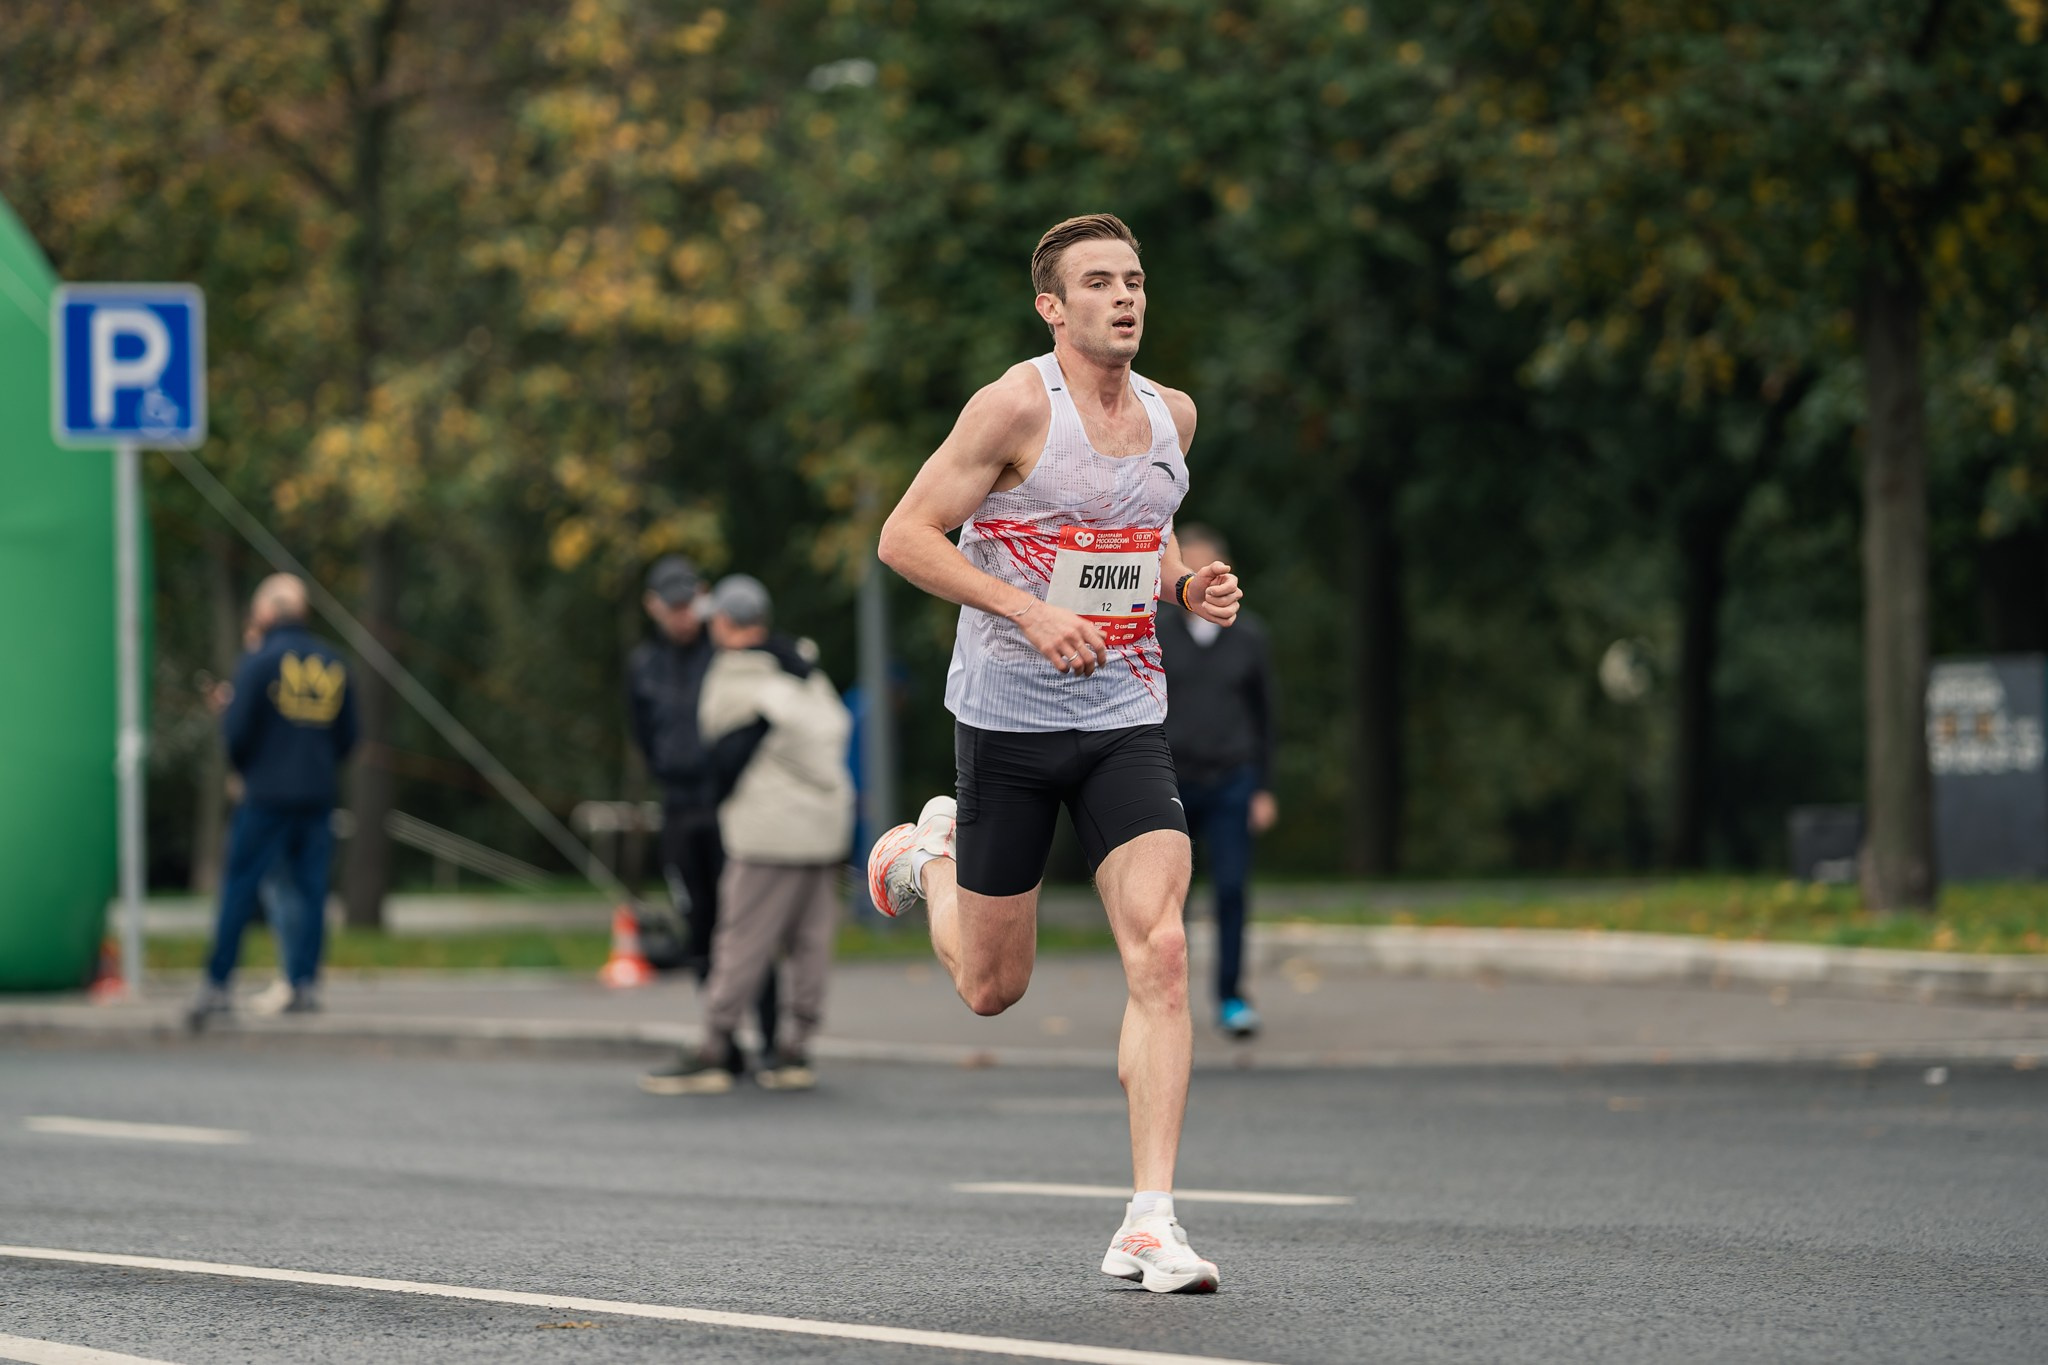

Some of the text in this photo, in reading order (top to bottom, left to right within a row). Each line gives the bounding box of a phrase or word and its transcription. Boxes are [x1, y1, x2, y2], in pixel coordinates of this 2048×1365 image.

[89, 305, 171, 425] P
[1079, 564, 1141, 590] БЯКИН
[1101, 602, 1112, 612] 12
